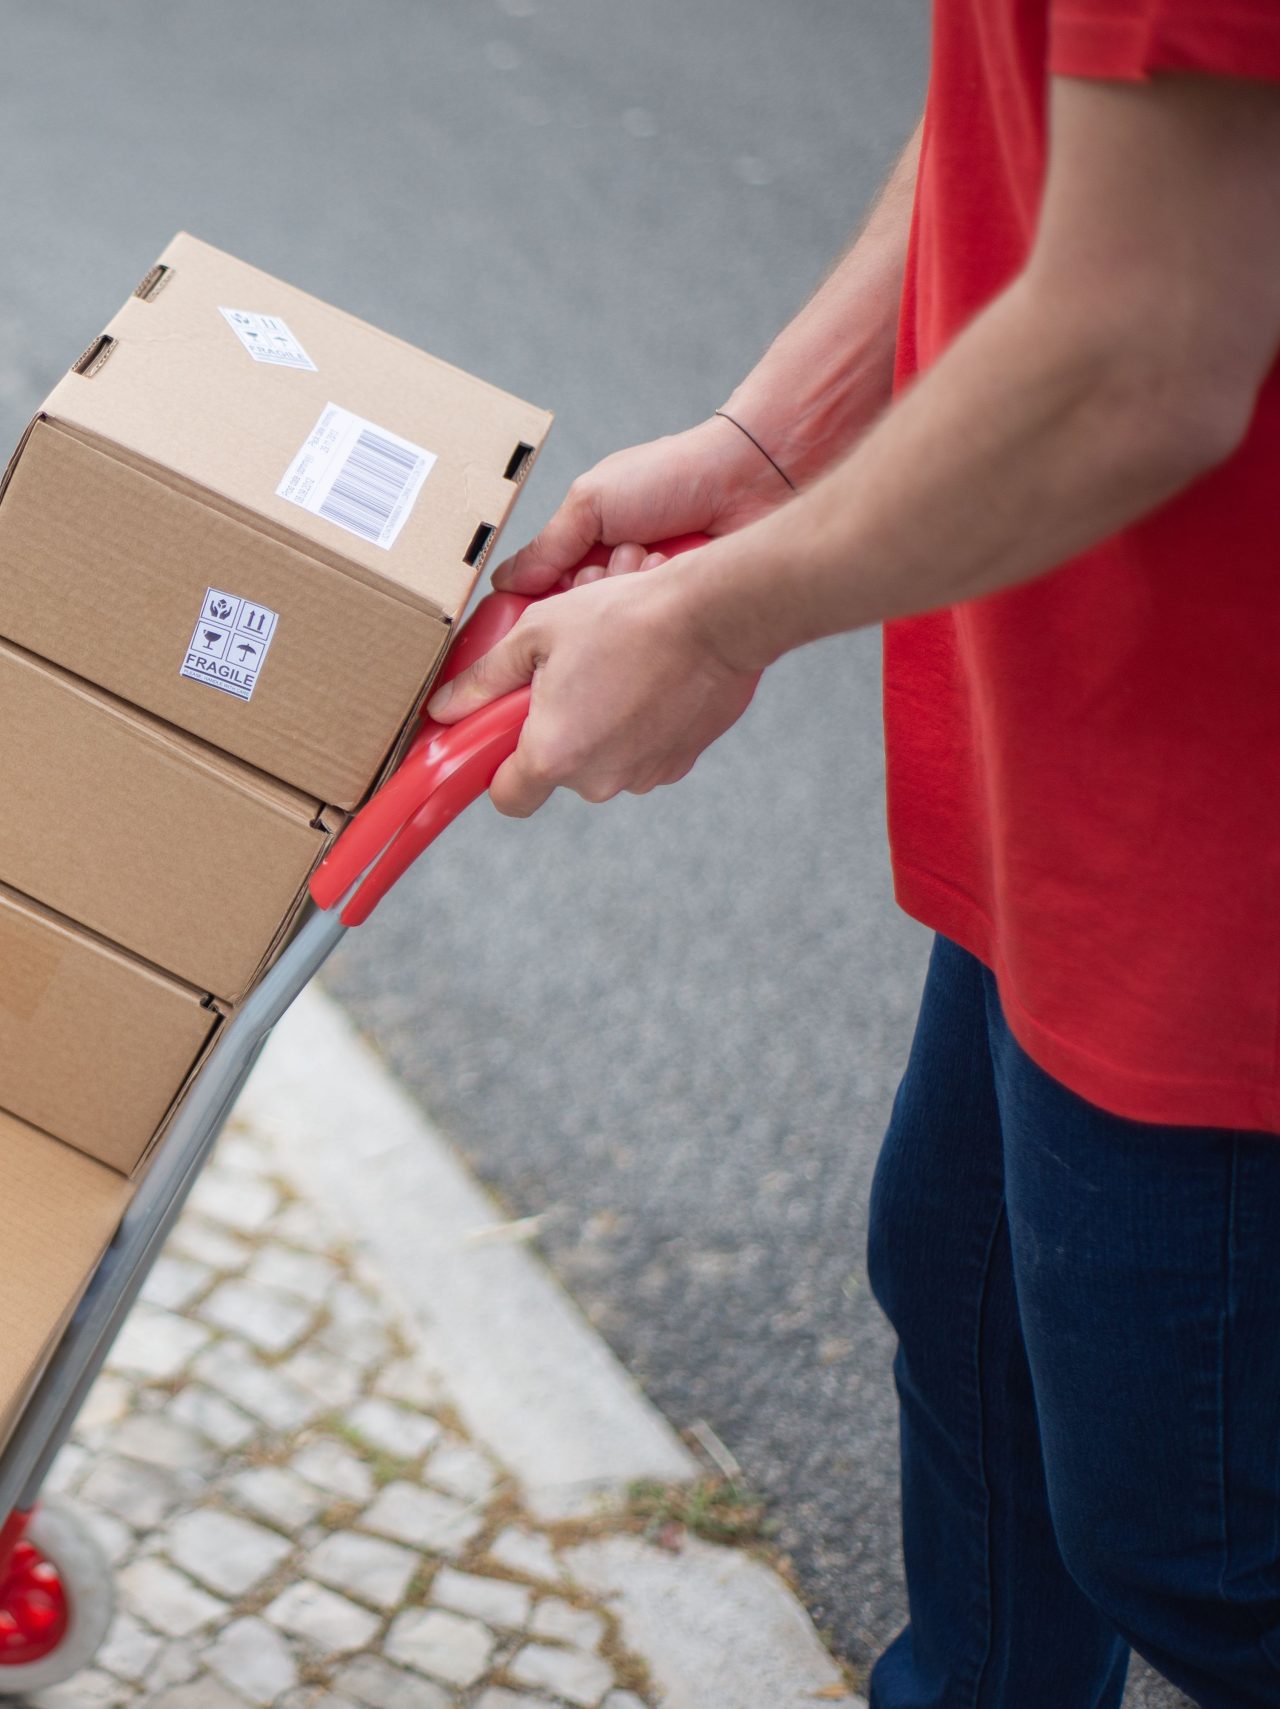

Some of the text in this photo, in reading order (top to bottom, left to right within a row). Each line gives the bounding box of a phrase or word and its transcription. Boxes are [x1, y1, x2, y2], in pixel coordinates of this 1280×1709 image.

[248, 345, 305, 359] FRAGILE
[186, 654, 254, 687] FRAGILE
[204, 676, 223, 685] HANDLE
